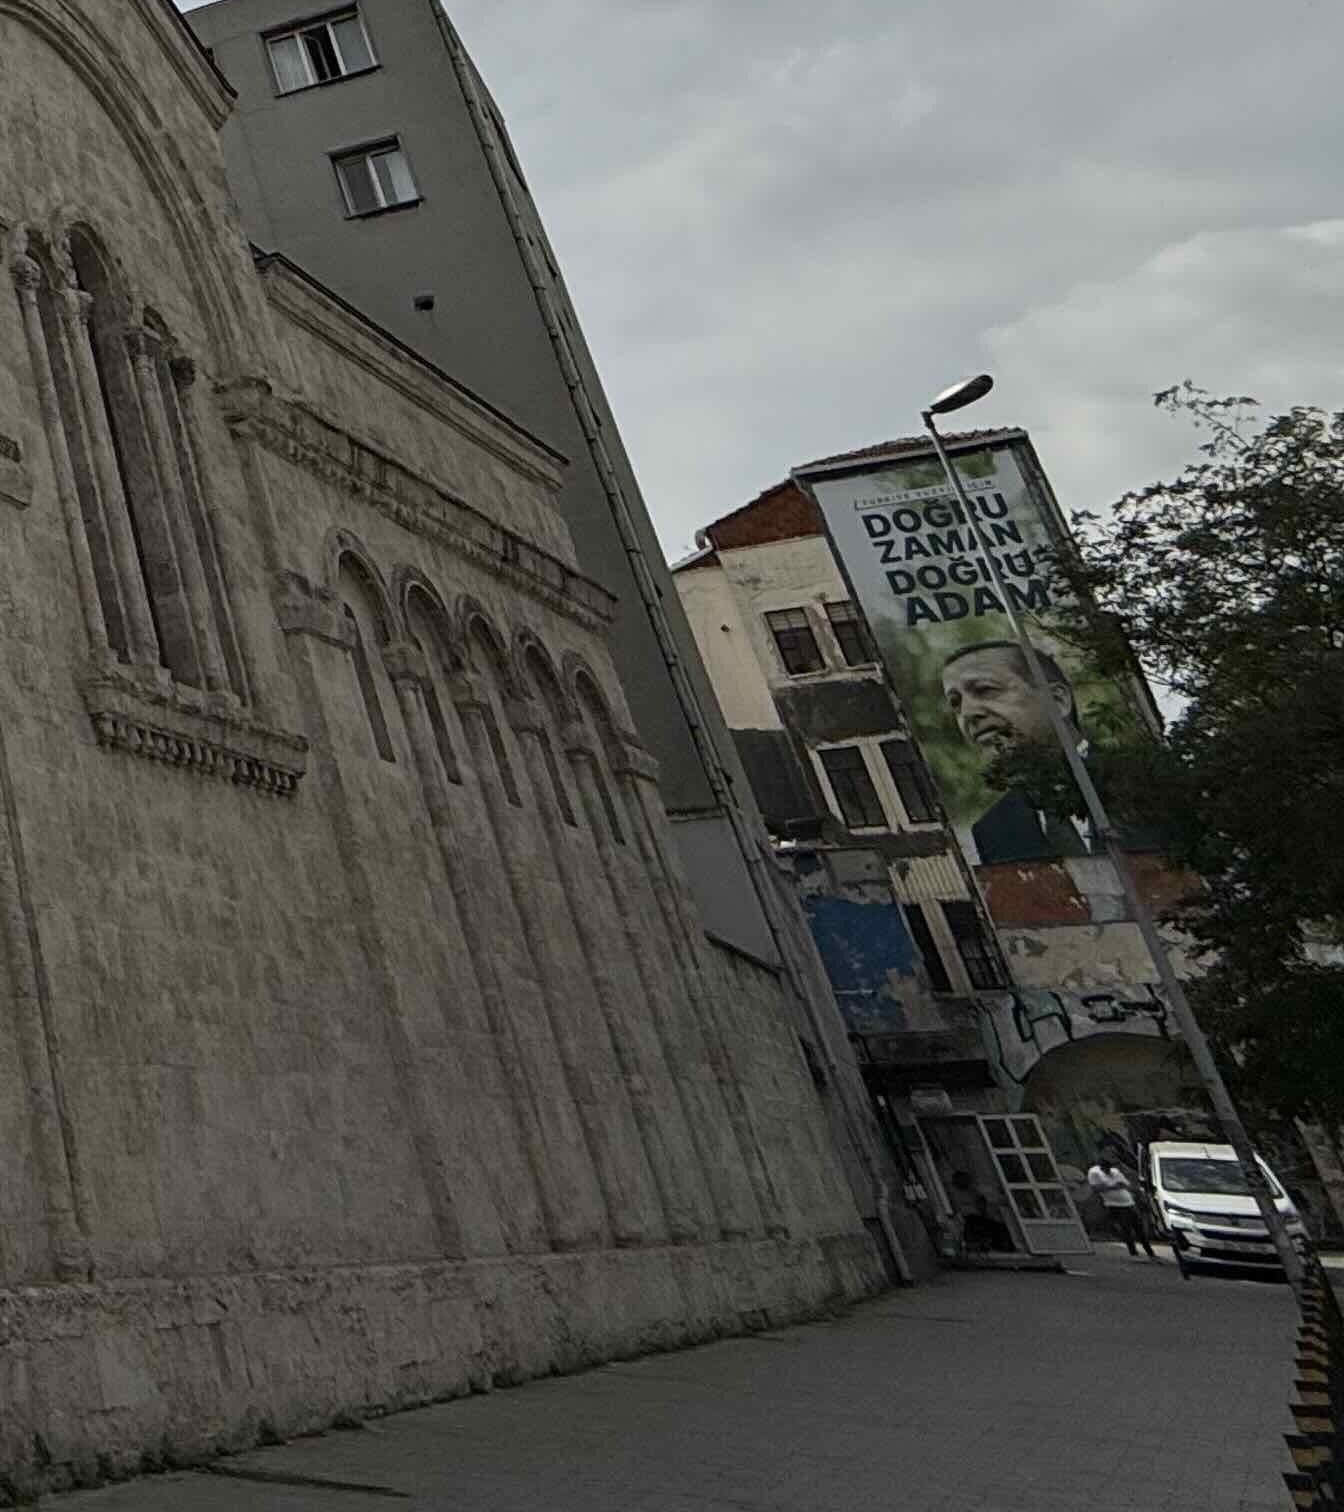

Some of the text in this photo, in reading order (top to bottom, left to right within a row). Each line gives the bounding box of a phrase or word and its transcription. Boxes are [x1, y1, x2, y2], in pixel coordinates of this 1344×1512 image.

[861, 492, 1009, 539] DOĞRU
[872, 520, 1023, 564] ZAMAN
[885, 549, 1036, 595] DOĞRU
[907, 578, 1052, 626] ADAM
